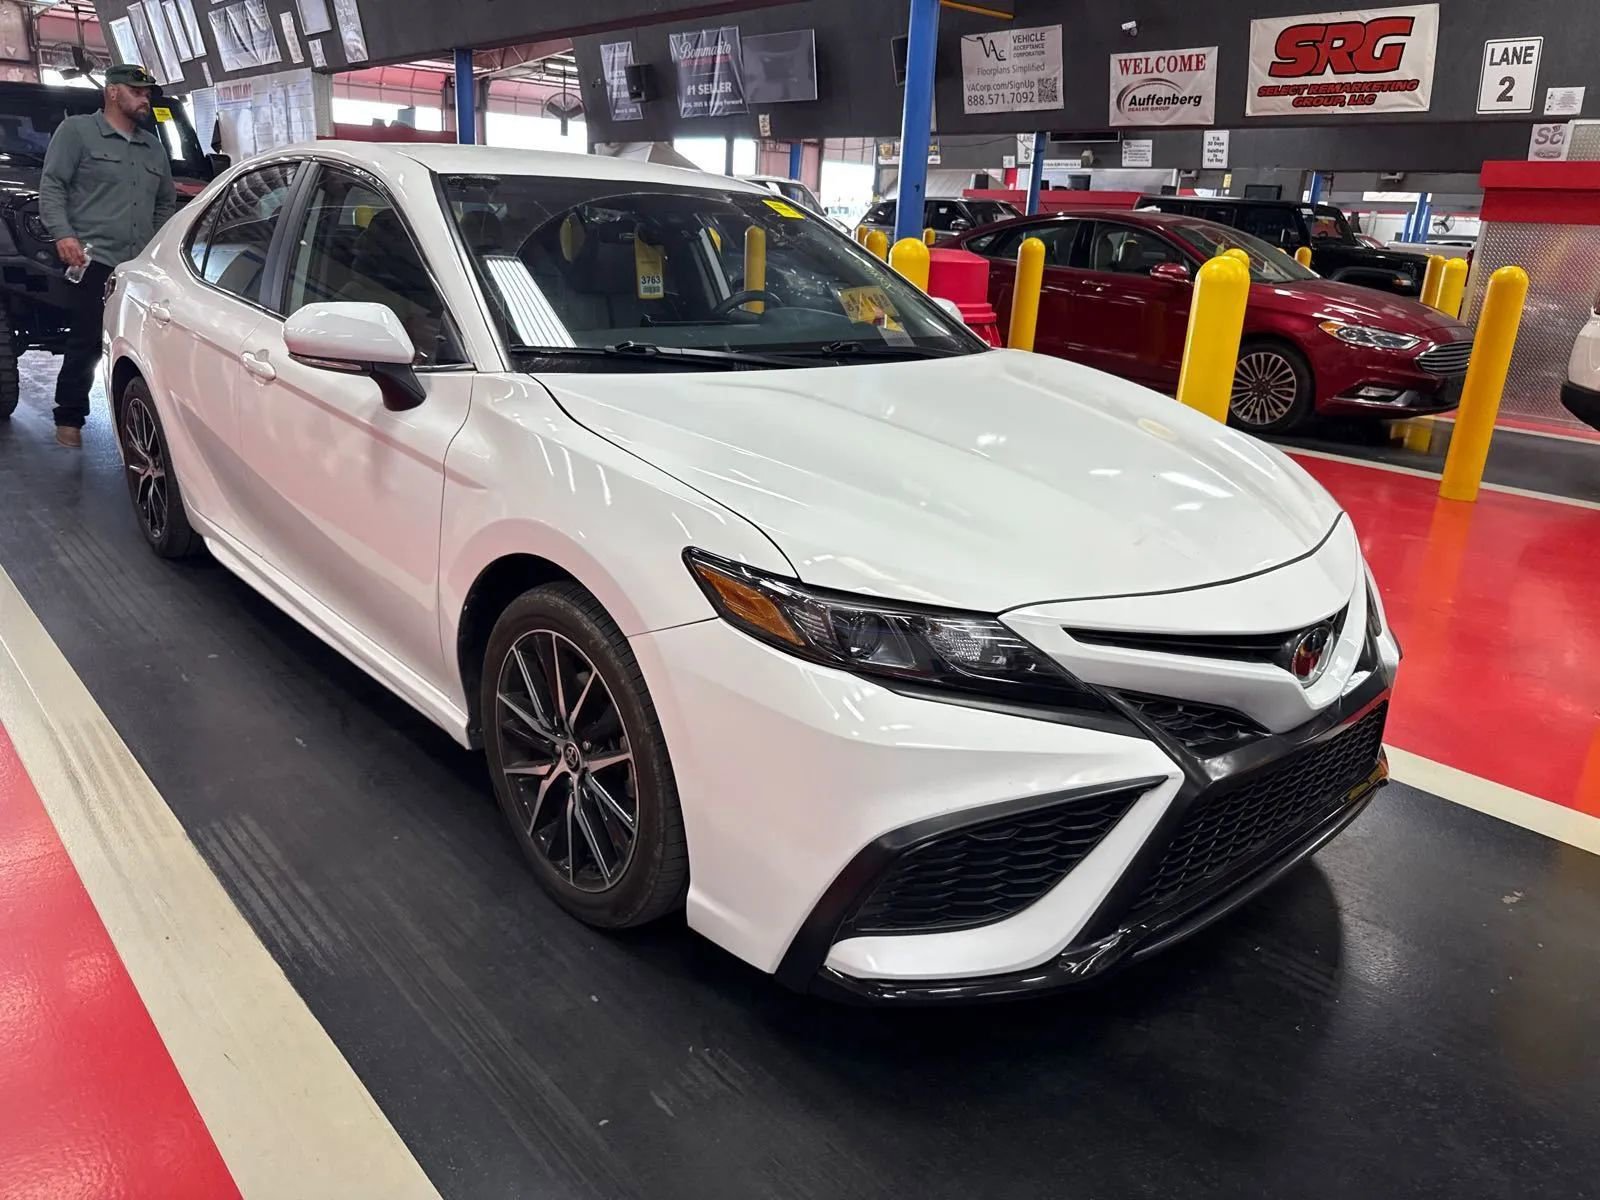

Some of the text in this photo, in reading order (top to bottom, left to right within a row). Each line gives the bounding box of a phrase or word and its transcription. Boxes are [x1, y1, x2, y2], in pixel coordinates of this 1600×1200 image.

[1012, 32, 1046, 44] VEHICLE
[1013, 43, 1045, 51] ACCEPTANCE
[1268, 16, 1415, 78] SRG
[1489, 46, 1535, 66] LANE
[977, 63, 1045, 76] Floorplans Simplified
[1118, 53, 1206, 77] WELCOME
[698, 81, 732, 96] SELLER
[966, 80, 1035, 92] VACorp.com/SignUp
[1257, 79, 1420, 98] SELECT REMARKETING
[1496, 76, 1516, 102] 2
[967, 91, 1036, 106] 888.571.7092
[1128, 94, 1202, 107] Auffenberg
[1292, 94, 1377, 109] GROUP, LLC
[1024, 148, 1030, 160] 5
[641, 275, 661, 285] 3763
